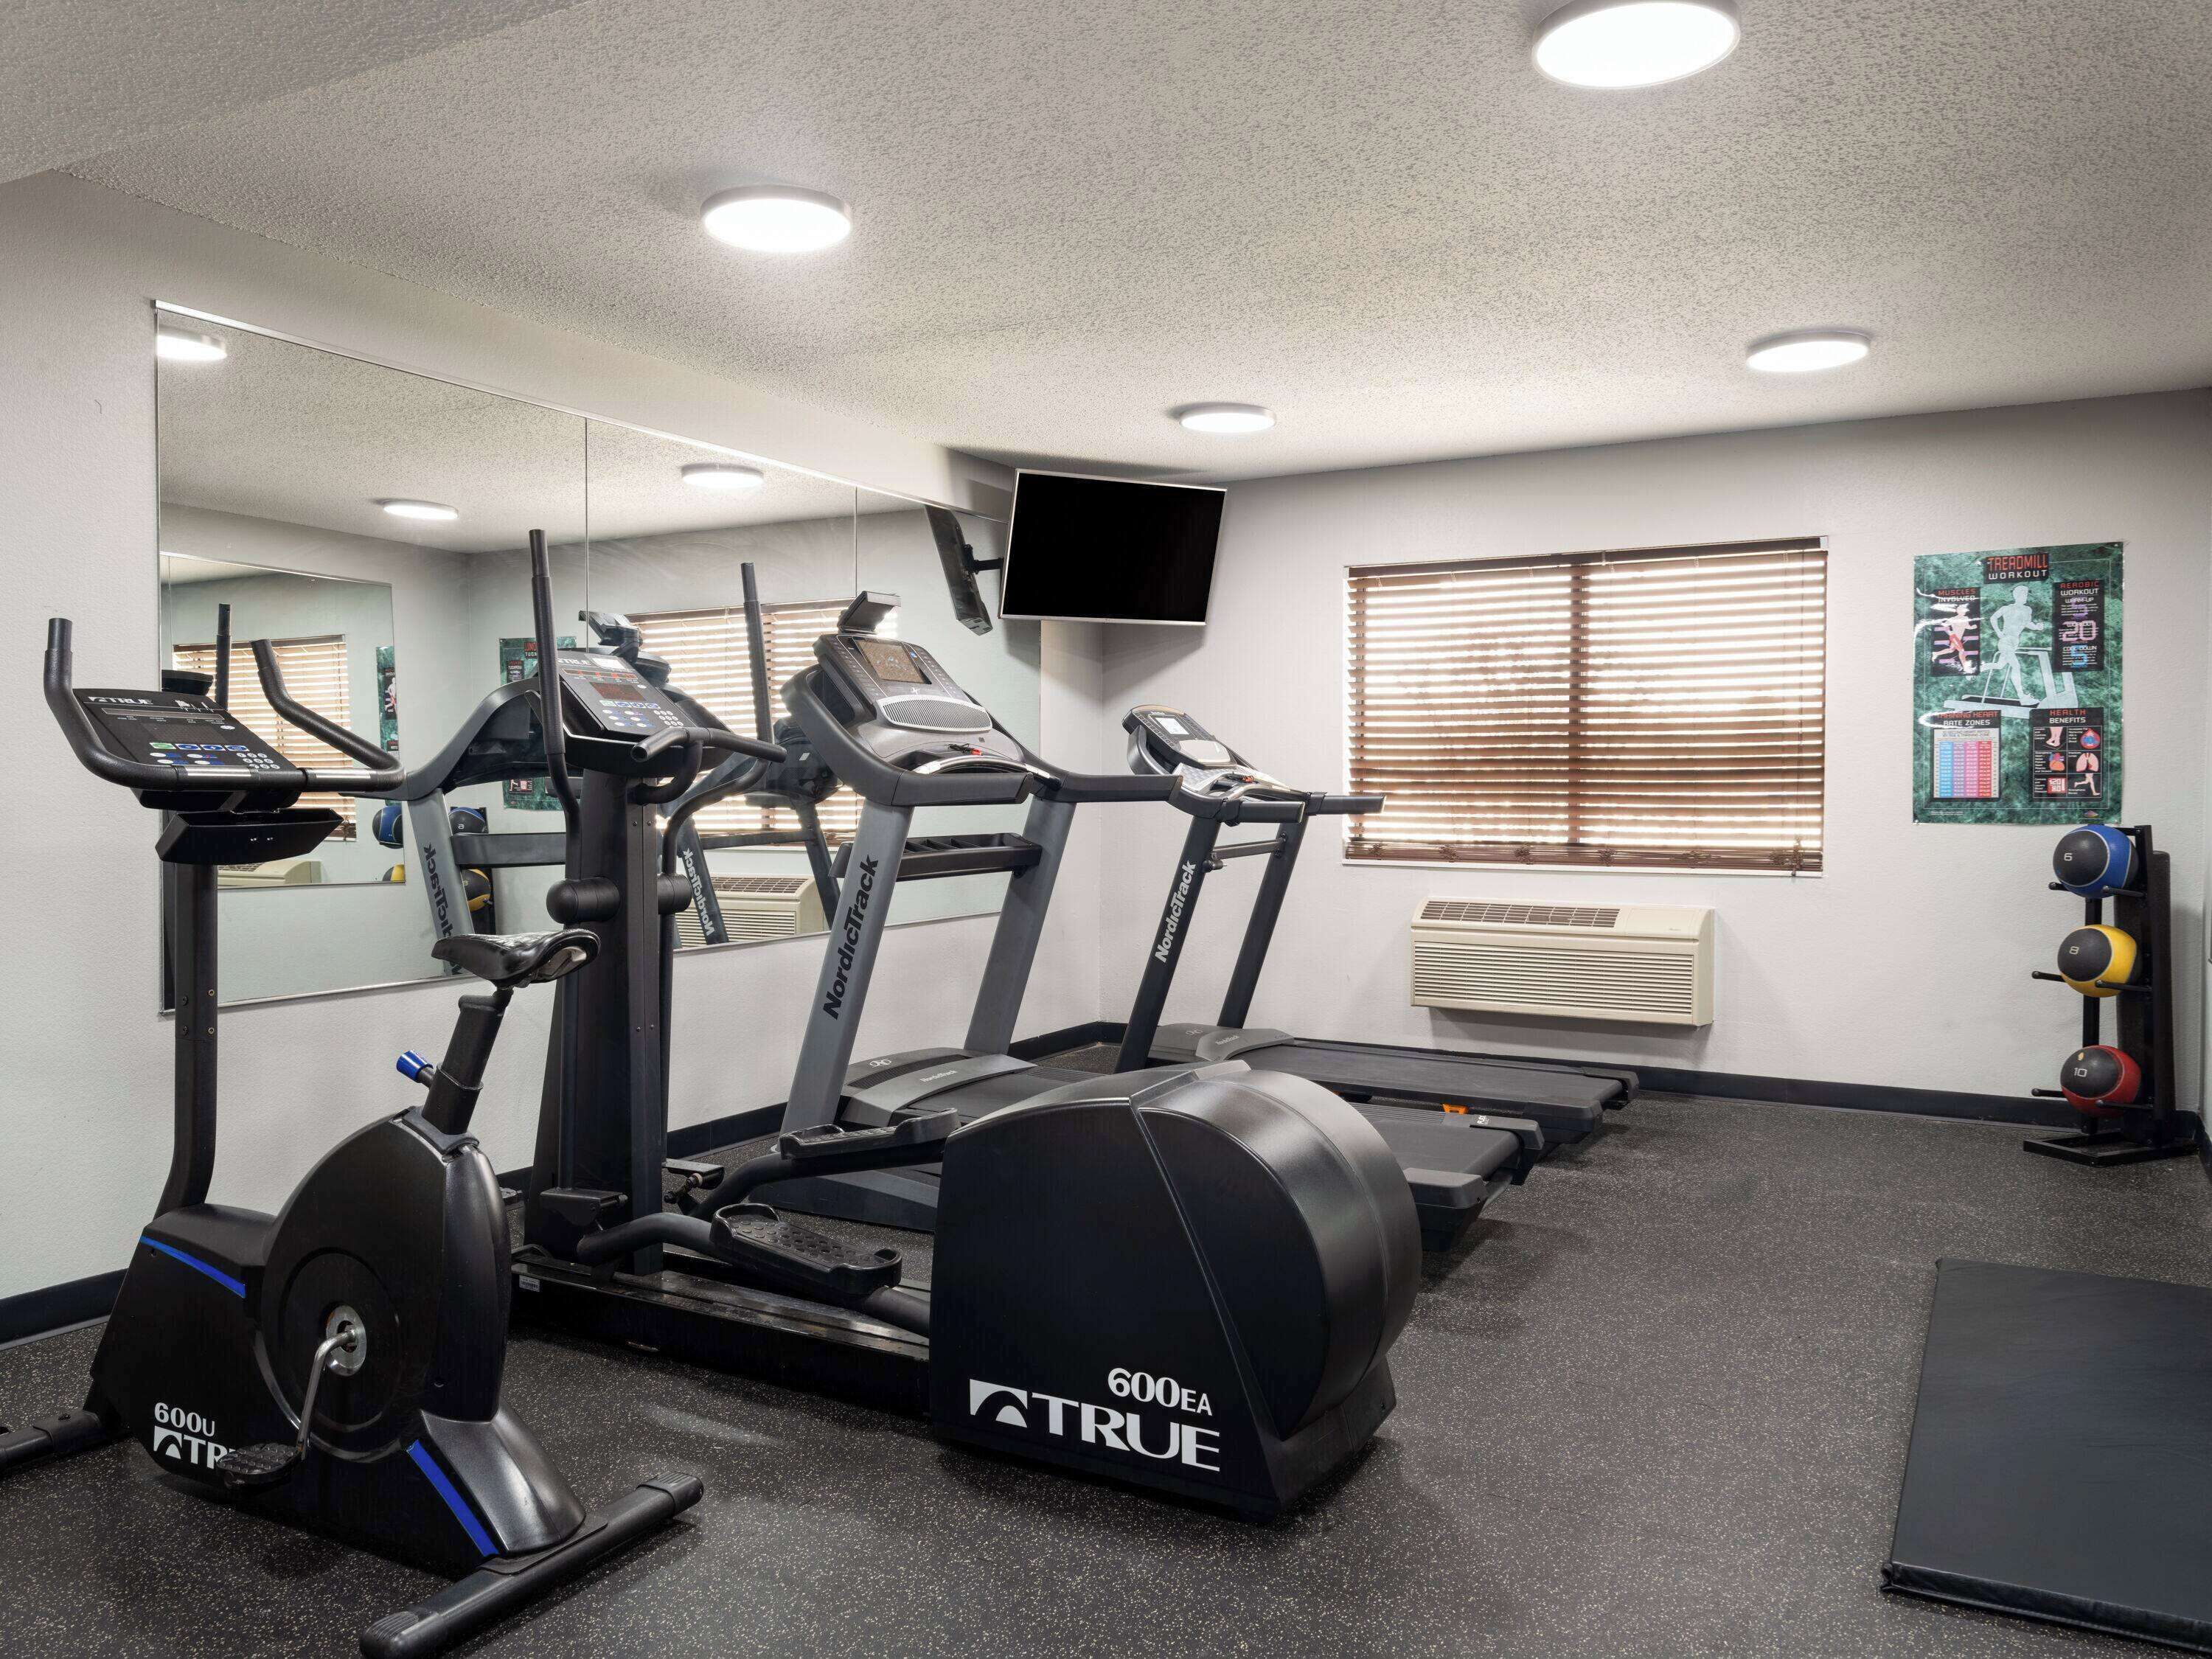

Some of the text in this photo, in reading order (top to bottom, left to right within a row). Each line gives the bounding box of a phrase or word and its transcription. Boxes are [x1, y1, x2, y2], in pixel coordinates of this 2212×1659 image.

[1988, 554, 2048, 571] TREADMILL
[1989, 569, 2048, 580] WORKOUT
[2060, 580, 2099, 588] AEROBIC
[1938, 588, 1977, 596] MUSCLES
[108, 697, 153, 705] TRUE
[2050, 709, 2086, 717] HEALTH
[2064, 852, 2073, 861] 6
[1155, 860, 1196, 963] NordicTrack
[823, 855, 879, 1020] NordicTrack
[2069, 946, 2080, 955] 8
[2073, 1067, 2087, 1077] 10
[1107, 1367, 1213, 1416] 600EA
[154, 1402, 215, 1438] 600U
[1032, 1391, 1220, 1472] TRUE
[183, 1434, 237, 1470] TR
